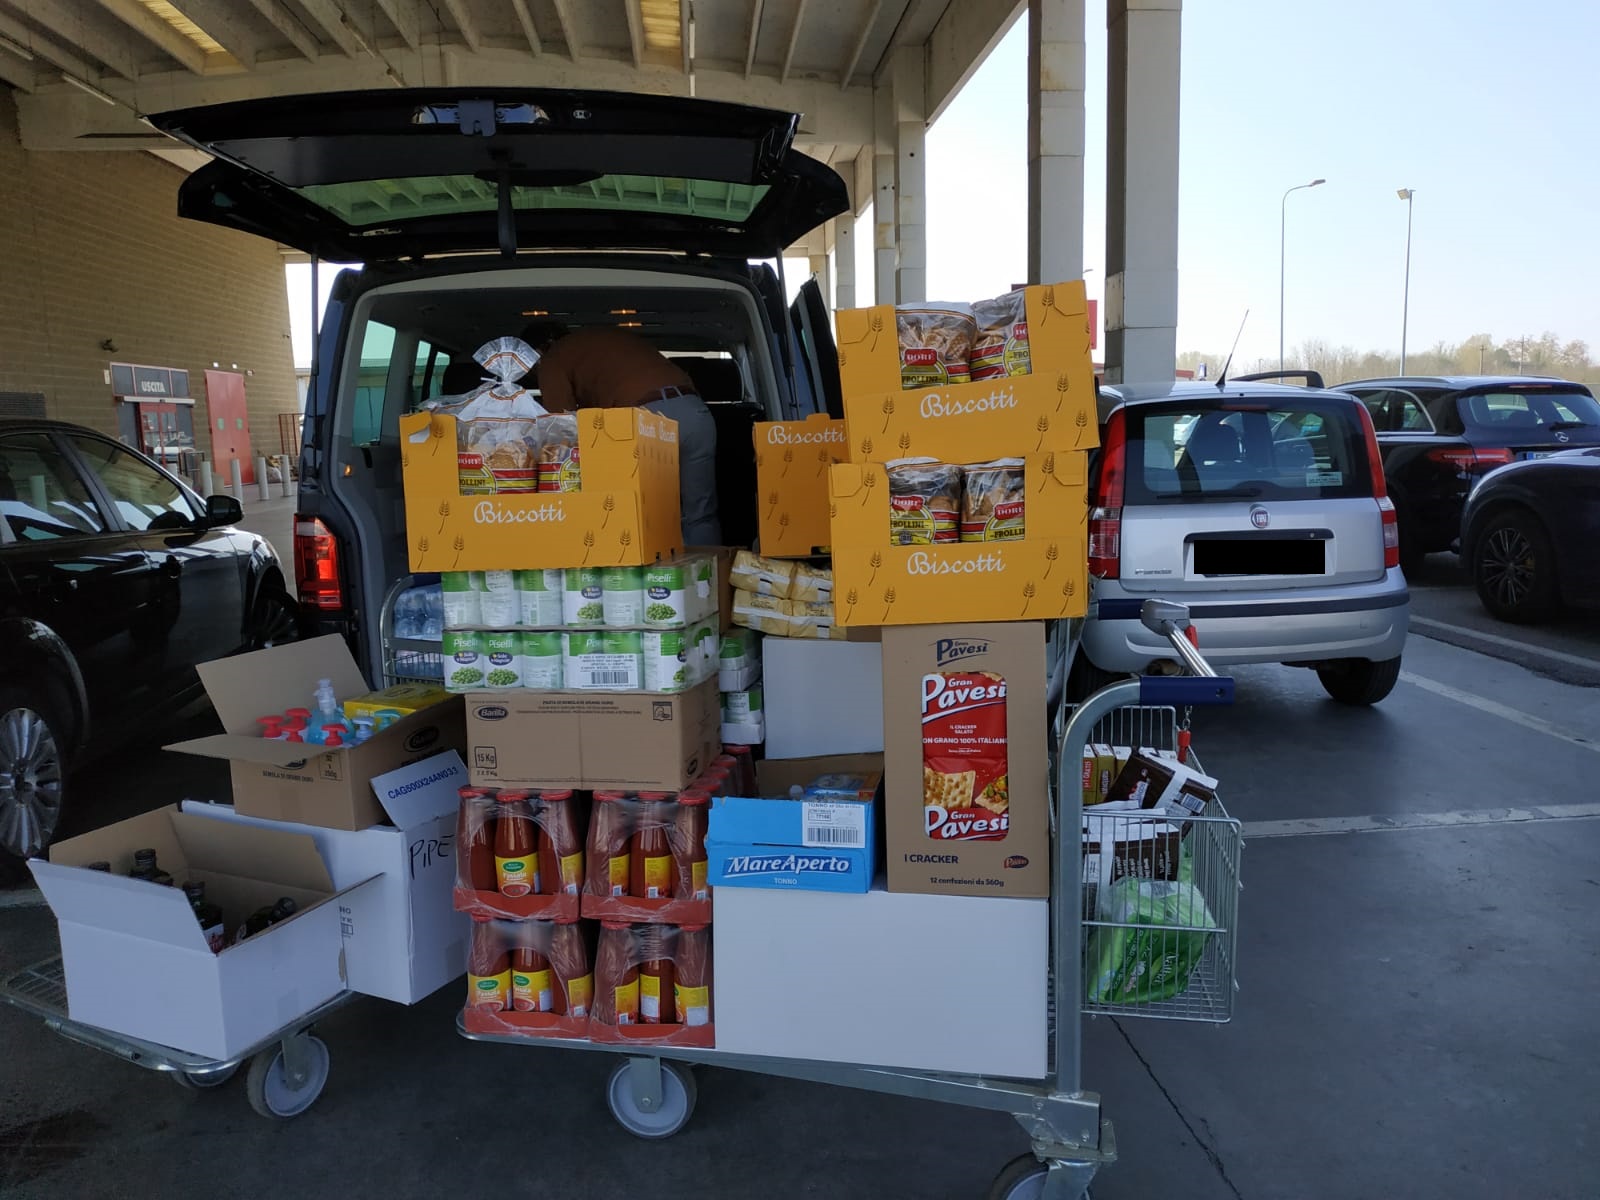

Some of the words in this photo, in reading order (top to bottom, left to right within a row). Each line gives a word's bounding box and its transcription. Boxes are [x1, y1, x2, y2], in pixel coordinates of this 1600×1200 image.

[141, 381, 165, 393] USCITA
[920, 386, 1018, 419] Biscotti
[767, 424, 846, 446] Biscotti
[459, 478, 485, 486] OLLINI
[473, 501, 566, 524] Biscotti
[994, 528, 1025, 538] FROLLI
[907, 550, 1006, 575] Biscotti
[648, 573, 671, 583] Piselli
[453, 638, 478, 648] Piselli
[488, 638, 513, 648] Piselli
[936, 638, 989, 662] Pavesi
[948, 678, 973, 687] Gran
[922, 673, 1007, 714] Pavesi
[480, 708, 506, 718] Barilla
[477, 753, 485, 762] 15
[486, 754, 494, 764] Kg
[388, 766, 458, 799] CAG500X24AN033
[951, 811, 975, 820] Gran
[924, 805, 1008, 838] Pavesi
[909, 854, 959, 864] CRACKER
[727, 855, 849, 874] MareAperto
[774, 877, 798, 885] TONNO
[938, 877, 975, 886] confezioni
[975, 878, 984, 886] da
[985, 879, 1004, 887] 560g
